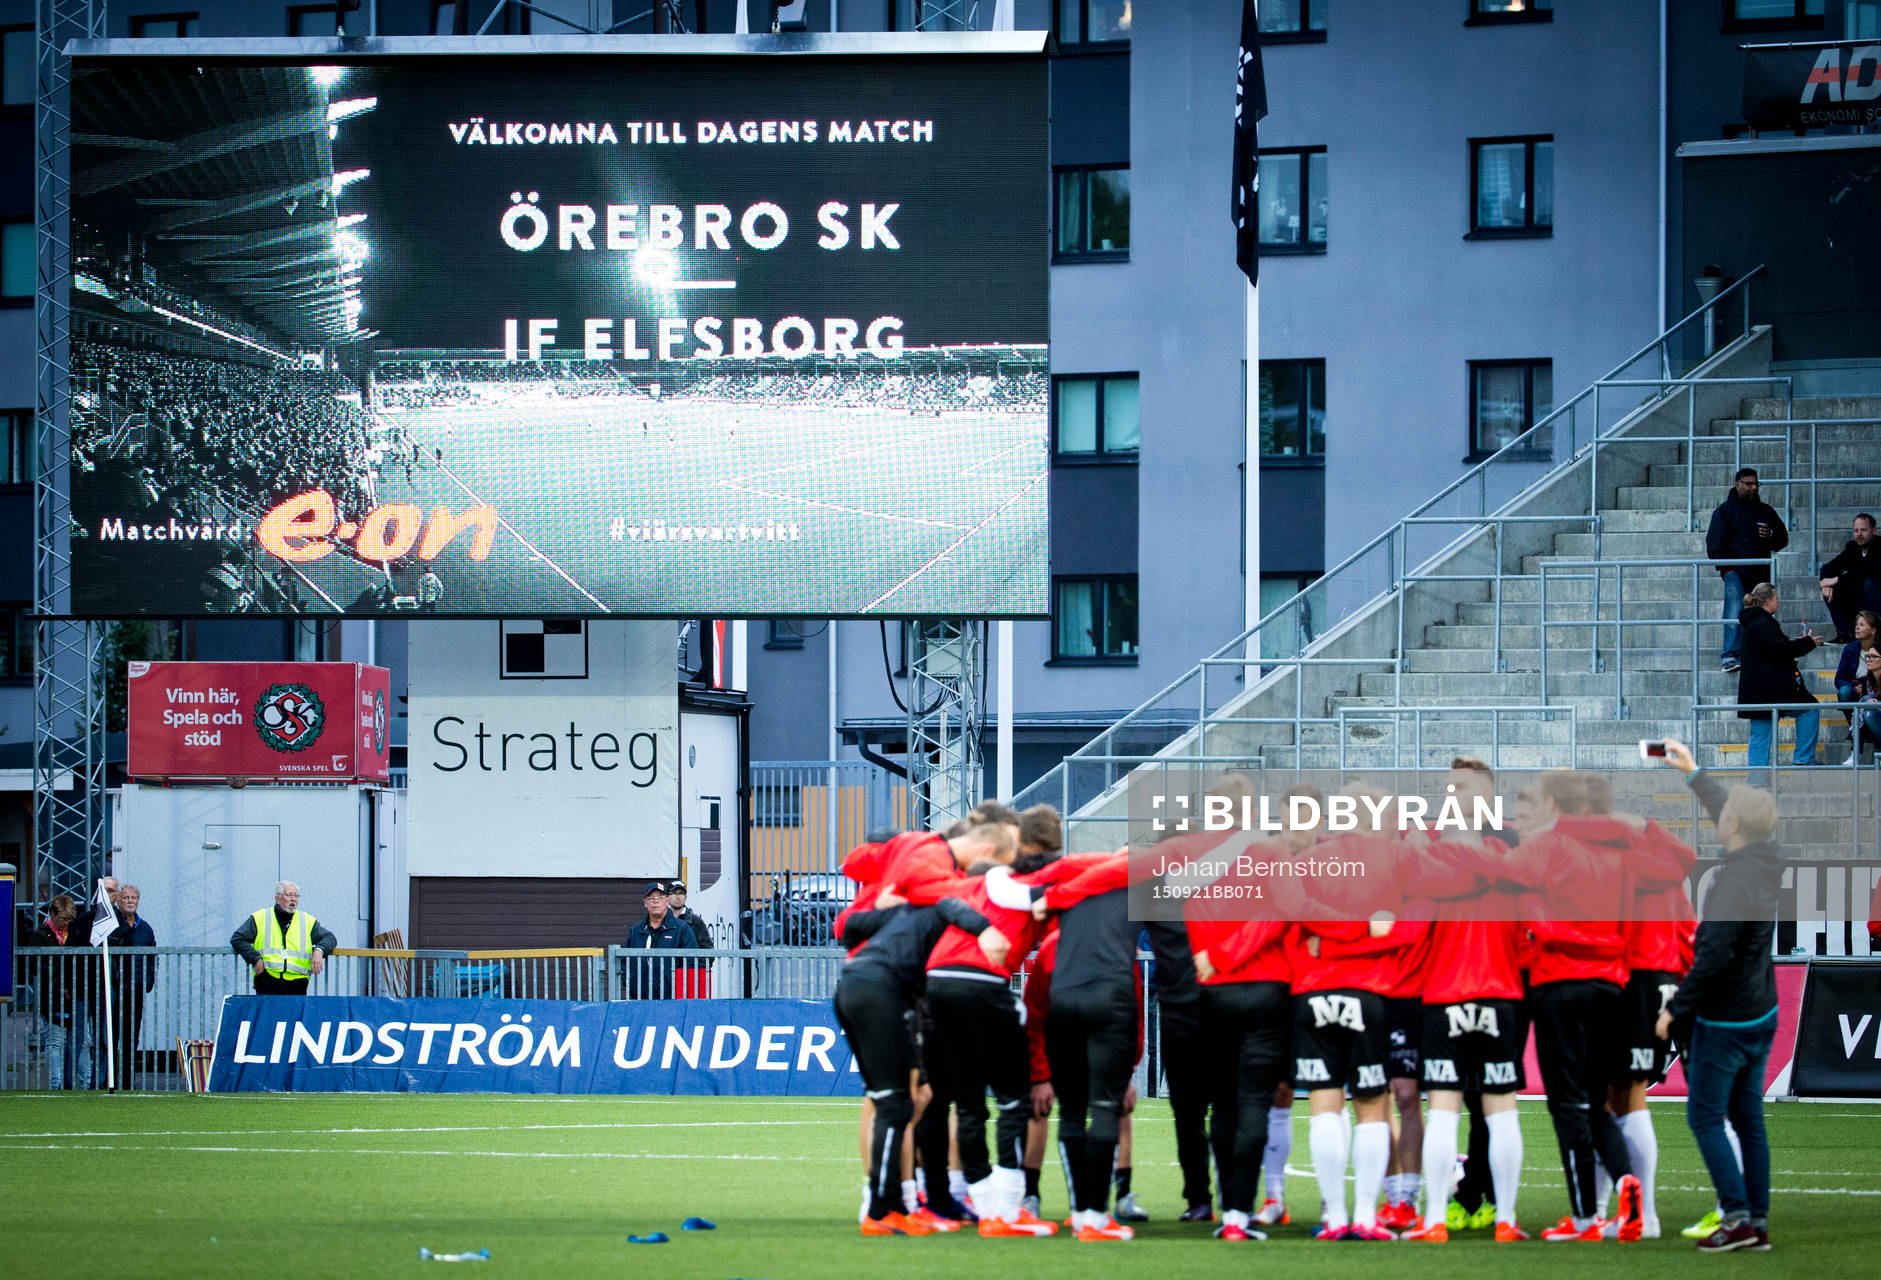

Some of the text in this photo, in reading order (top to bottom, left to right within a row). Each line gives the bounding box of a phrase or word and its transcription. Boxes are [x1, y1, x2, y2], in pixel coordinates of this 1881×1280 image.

[448, 118, 934, 145] VÄLKOMNA TILL DAGENS MATCH
[500, 191, 901, 252] ÖREBRO SK
[504, 315, 905, 361] IF ELFSBORG
[166, 686, 240, 706] Vinn här,
[163, 709, 243, 728] Spela och
[184, 729, 222, 747] stöd
[432, 715, 658, 788] Strateg
[279, 764, 330, 772] SVENSKA SPEL
[1308, 994, 1366, 1033] NA
[1445, 1002, 1500, 1038] NA
[234, 1013, 582, 1069] LINDSTRÖM
[1295, 1057, 1332, 1082] NA
[1357, 1063, 1387, 1089] NA
[1423, 1058, 1460, 1083] NA
[1483, 1060, 1518, 1085] NA
